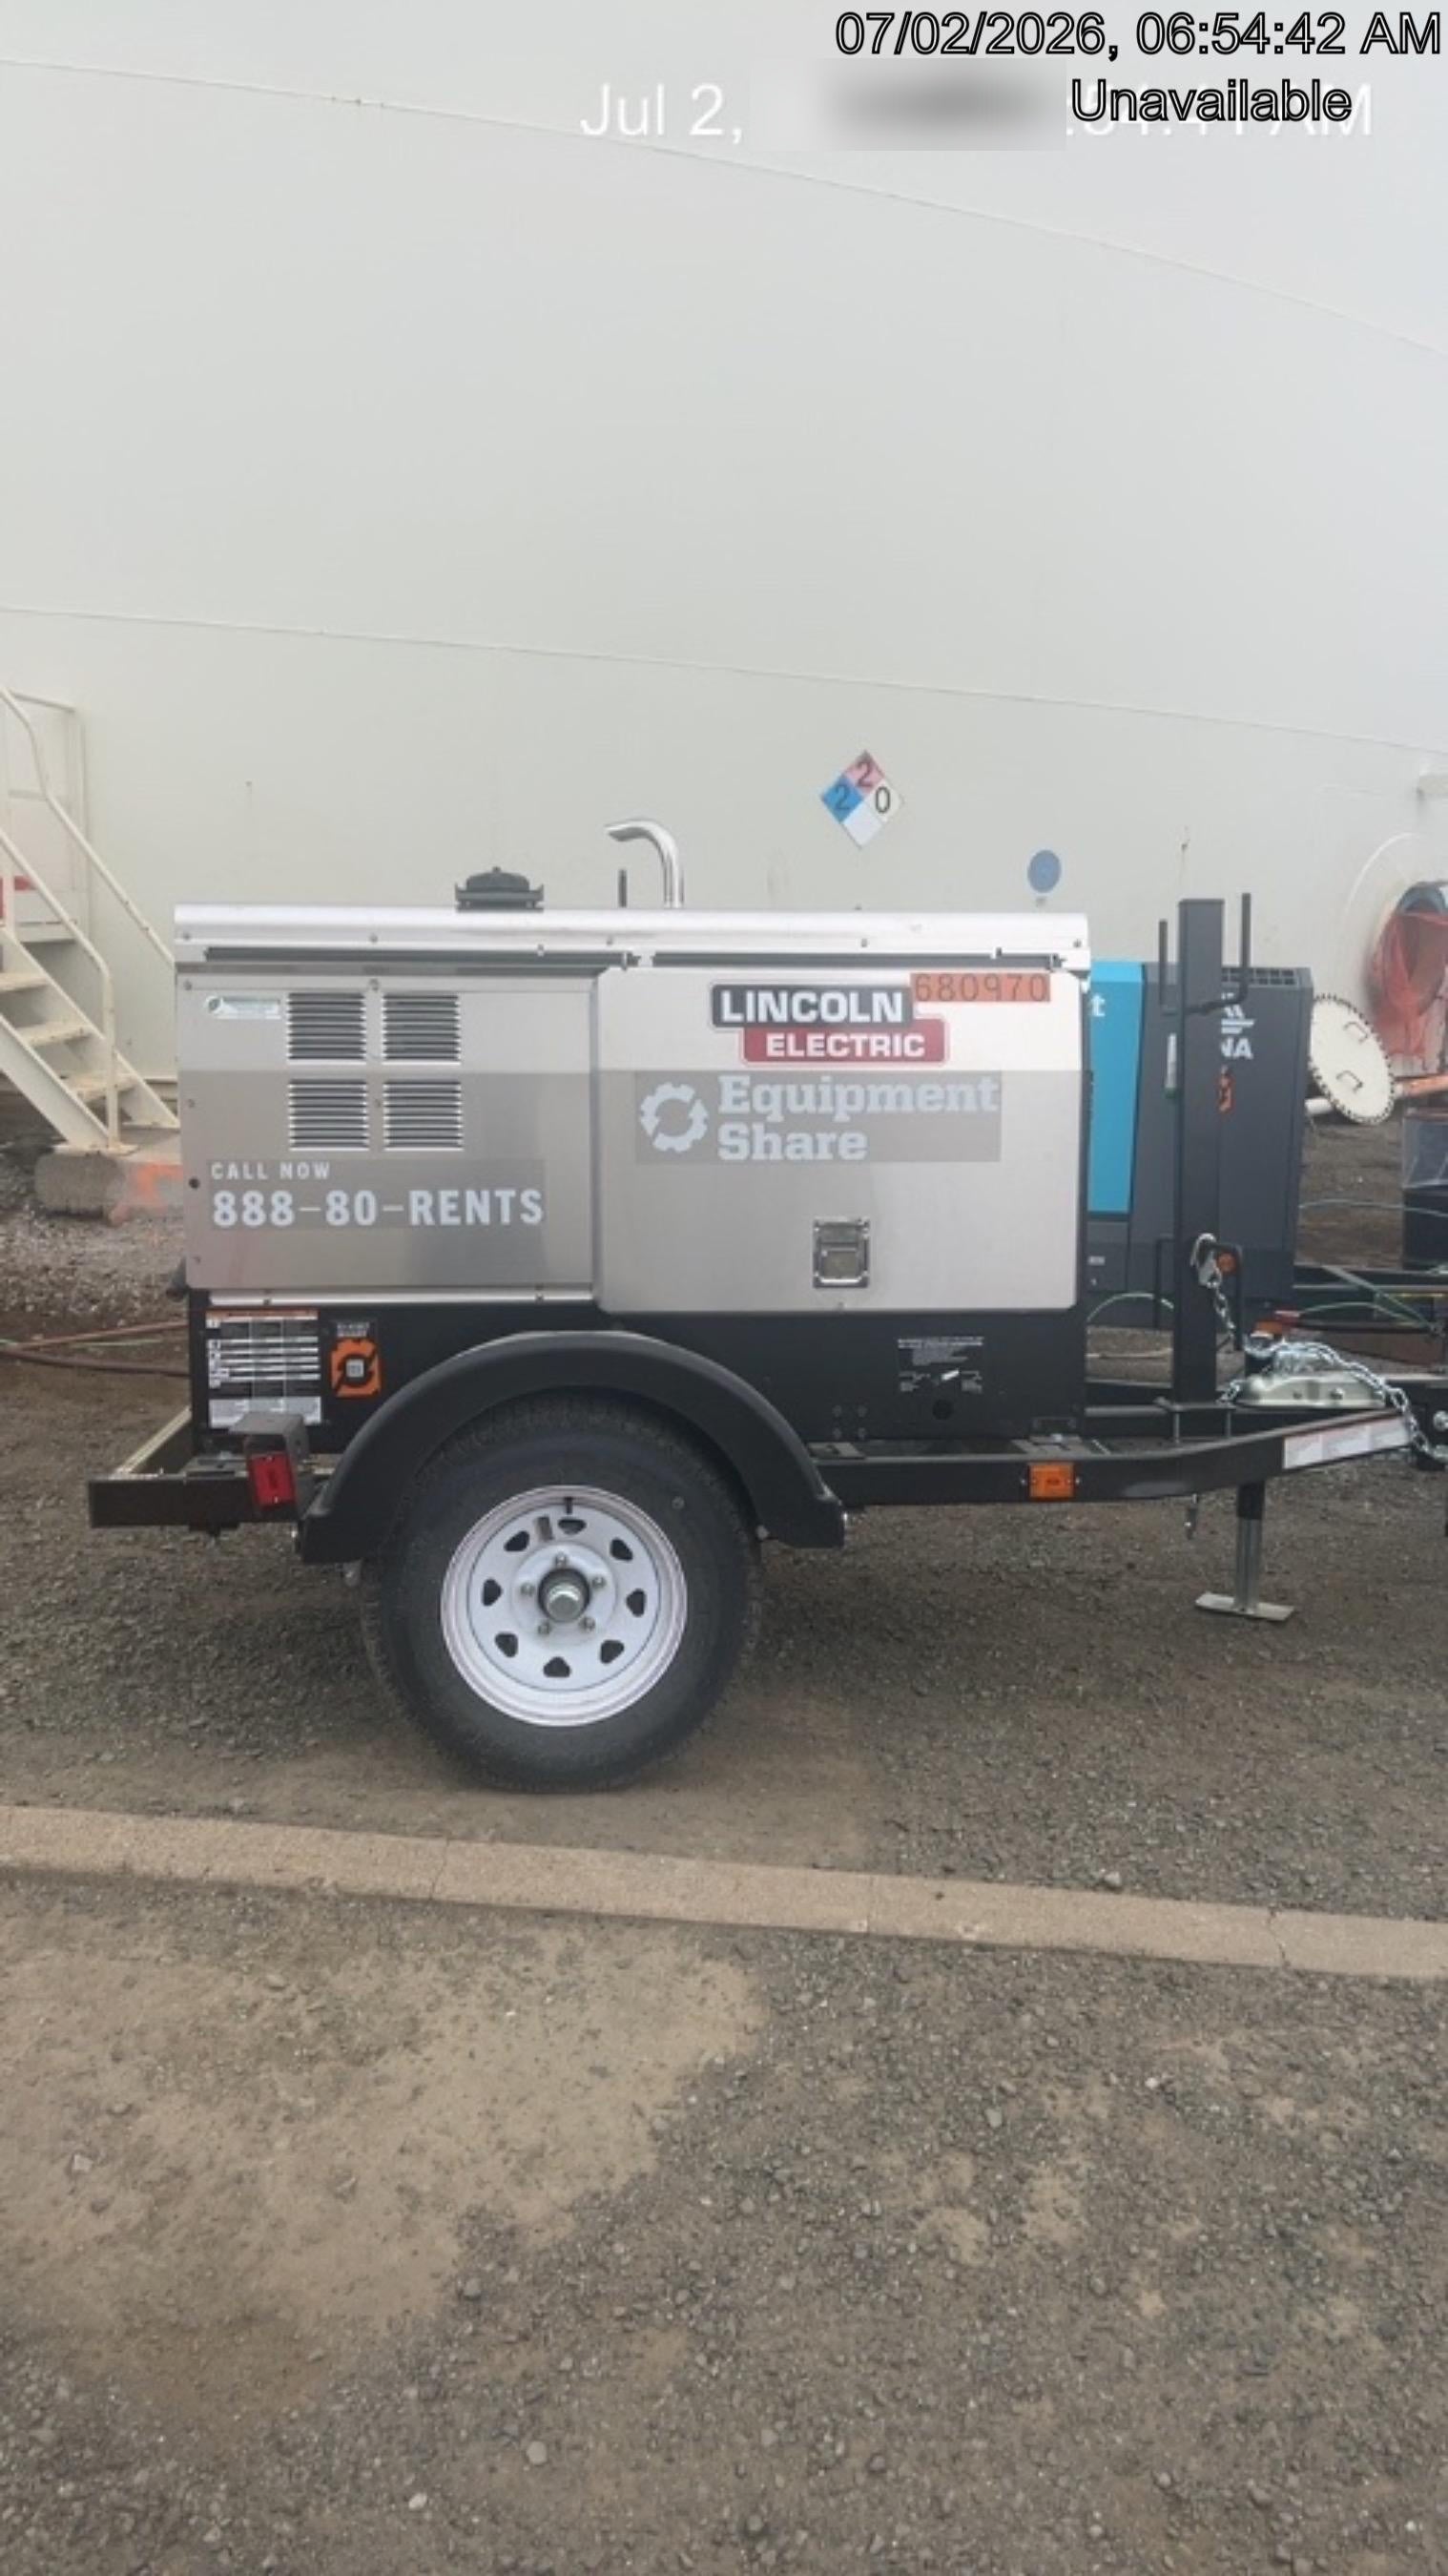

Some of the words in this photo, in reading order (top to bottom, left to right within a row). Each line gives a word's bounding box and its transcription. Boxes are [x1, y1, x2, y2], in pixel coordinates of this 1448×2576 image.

[855, 760, 874, 788] 2
[834, 782, 852, 811] 2
[875, 785, 891, 814] 0
[915, 973, 1047, 1002] 680970
[720, 990, 903, 1023] LINCOLN
[766, 1032, 925, 1057] ELECTRIC
[717, 1074, 1000, 1123] Equipment
[717, 1121, 868, 1161] Share
[211, 1162, 268, 1180] CALL
[279, 1162, 331, 1179] NOW
[213, 1190, 544, 1227] 888-80-RENTS
